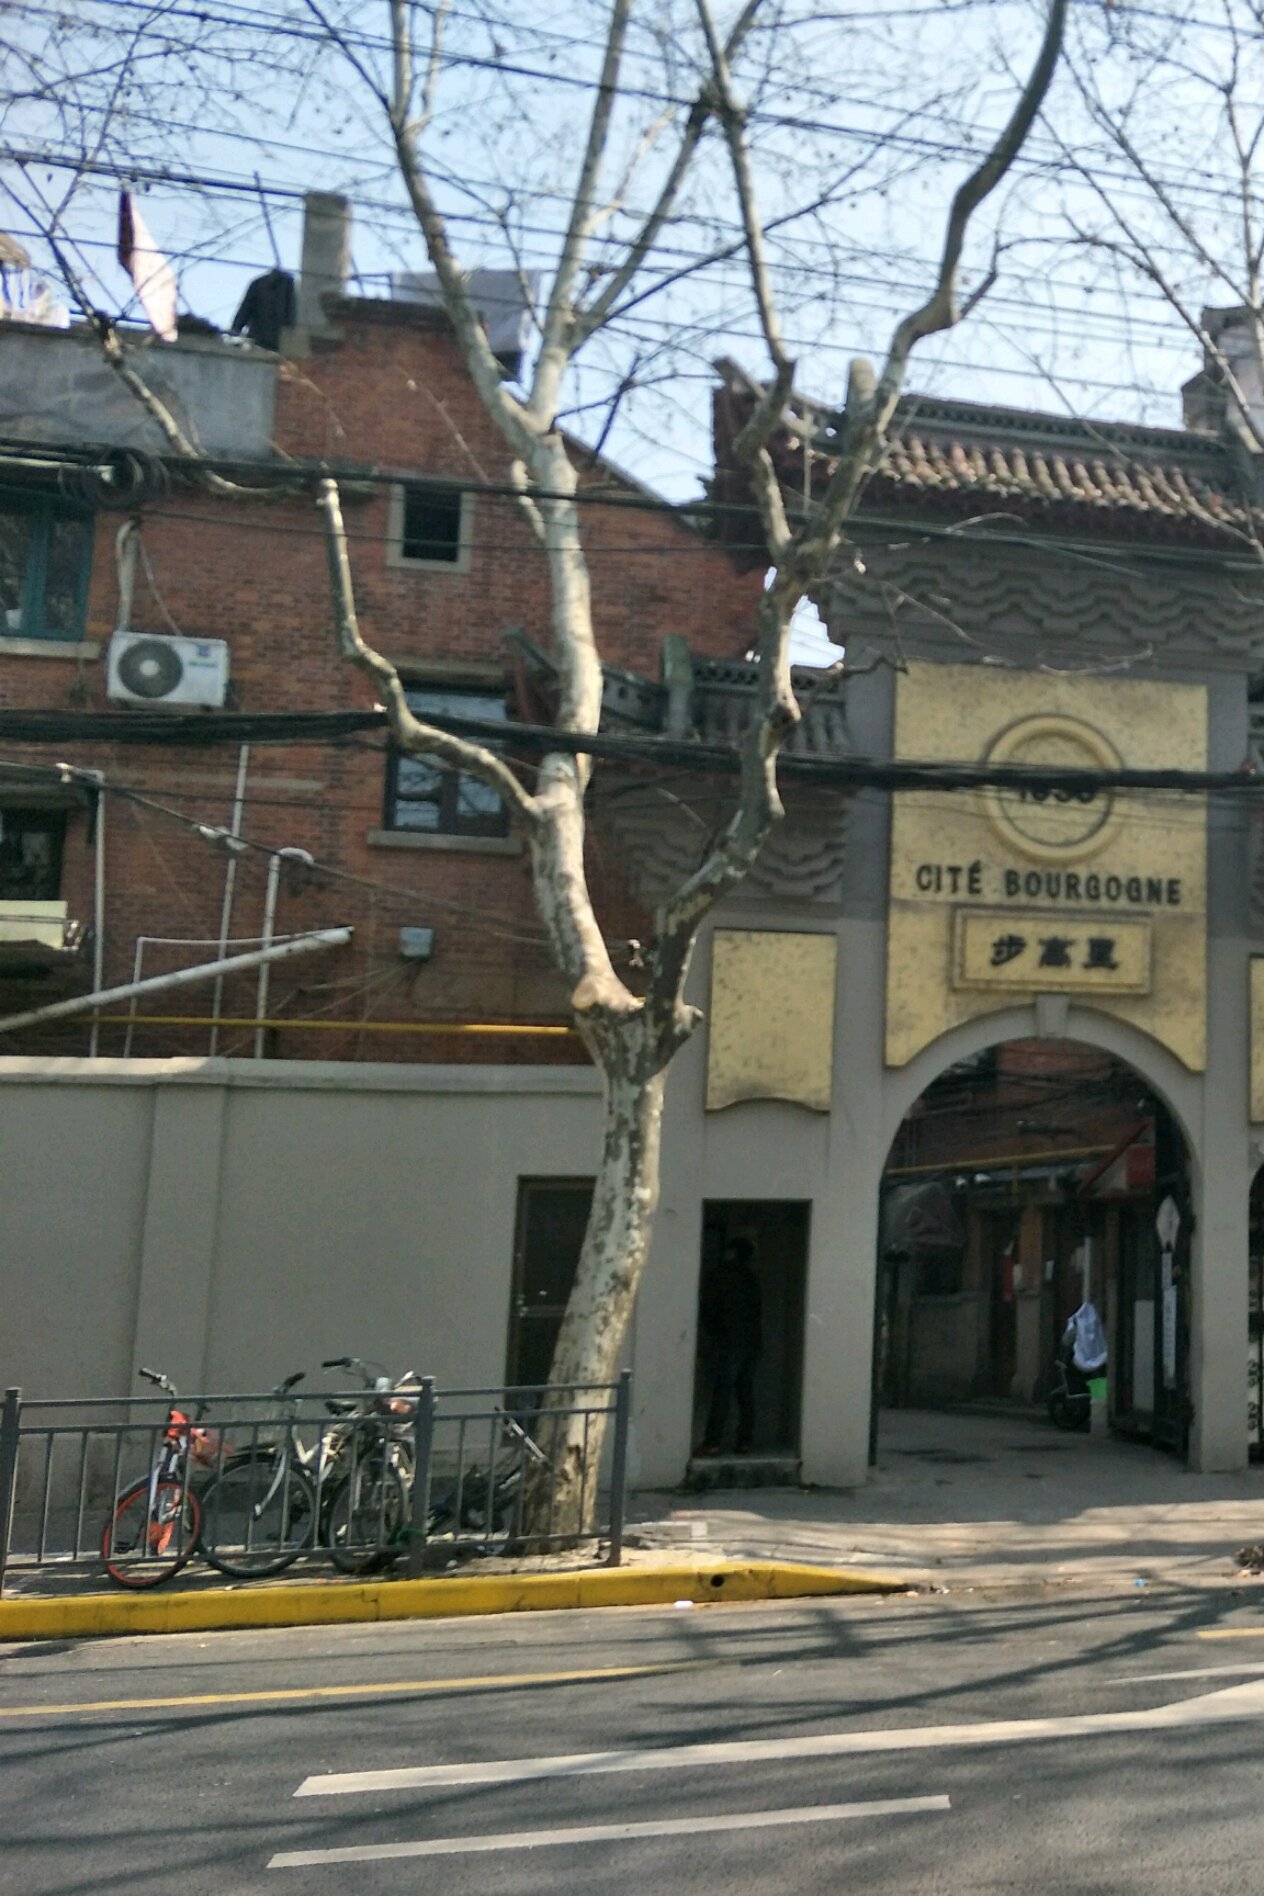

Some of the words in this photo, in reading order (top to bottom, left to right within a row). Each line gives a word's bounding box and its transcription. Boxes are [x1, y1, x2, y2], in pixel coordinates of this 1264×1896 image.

[916, 860, 983, 894] CITÉ
[1004, 868, 1182, 904] BOURGOGNE
[989, 934, 1120, 971] 步高里
